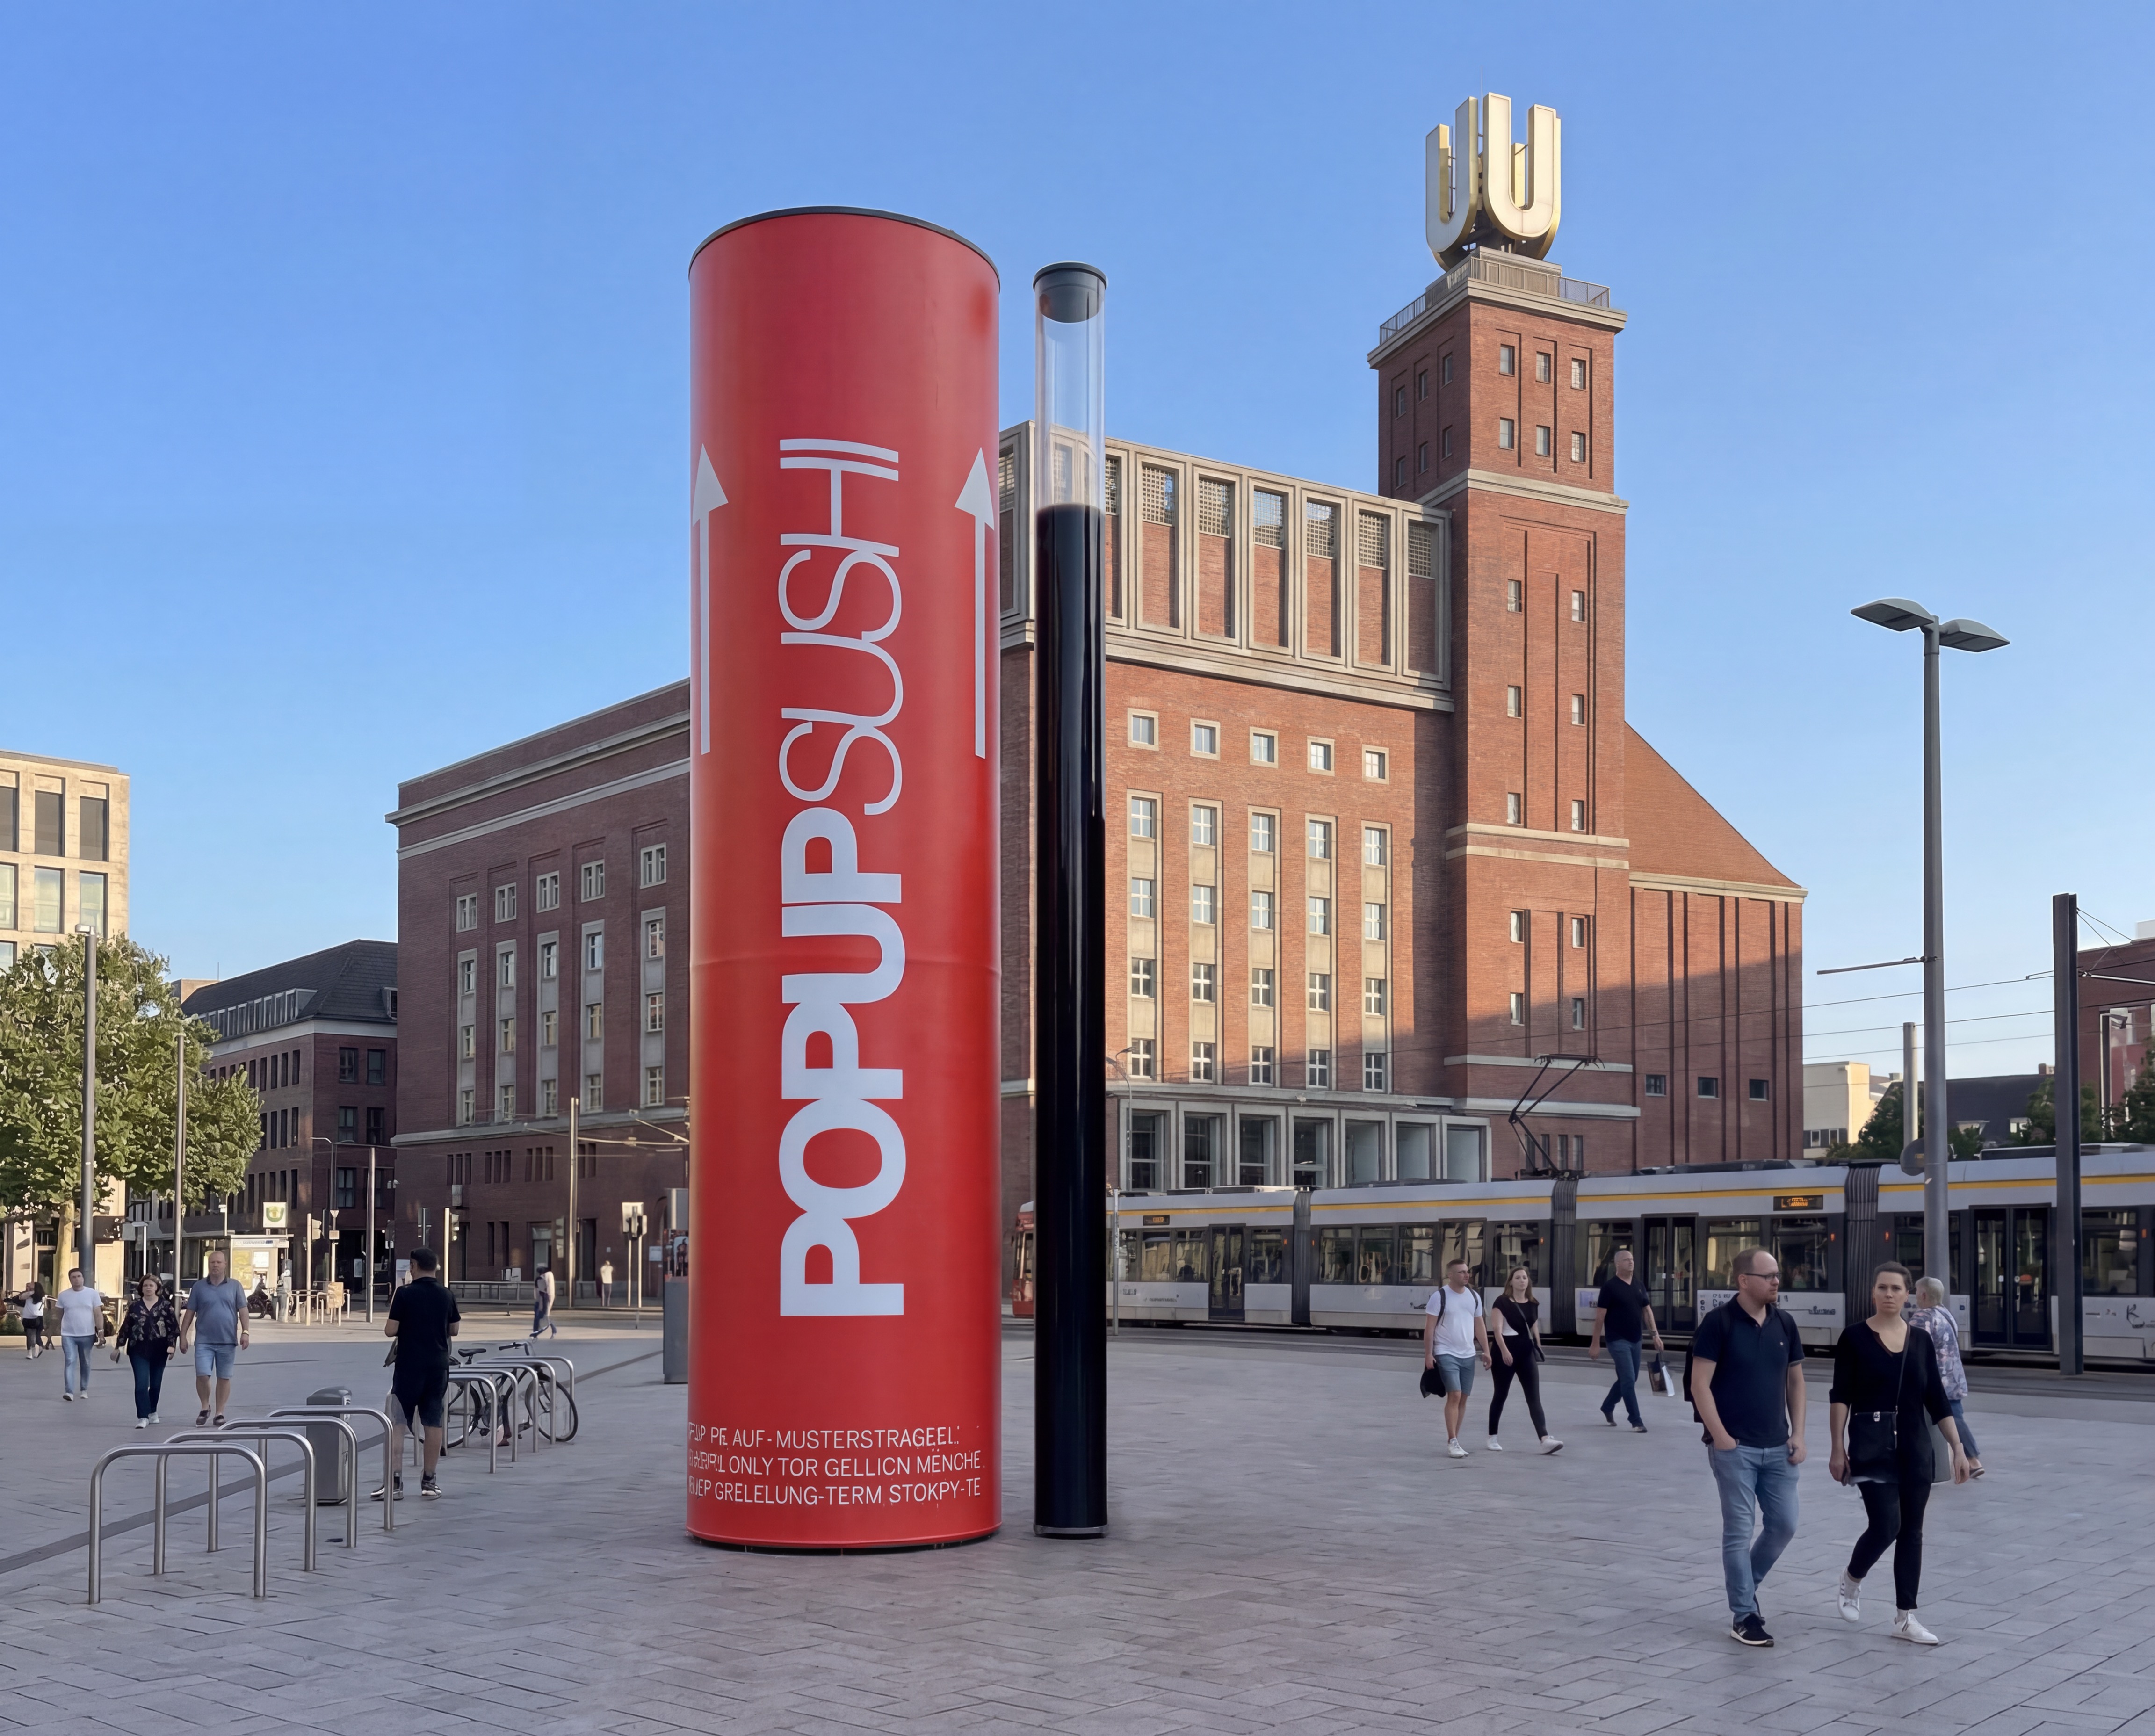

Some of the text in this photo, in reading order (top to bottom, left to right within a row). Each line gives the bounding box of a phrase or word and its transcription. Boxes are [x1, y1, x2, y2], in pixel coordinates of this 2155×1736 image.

[729, 1455, 774, 1476] ONLY
[777, 1457, 818, 1476] TOR
[824, 1457, 910, 1477] GELLICN
